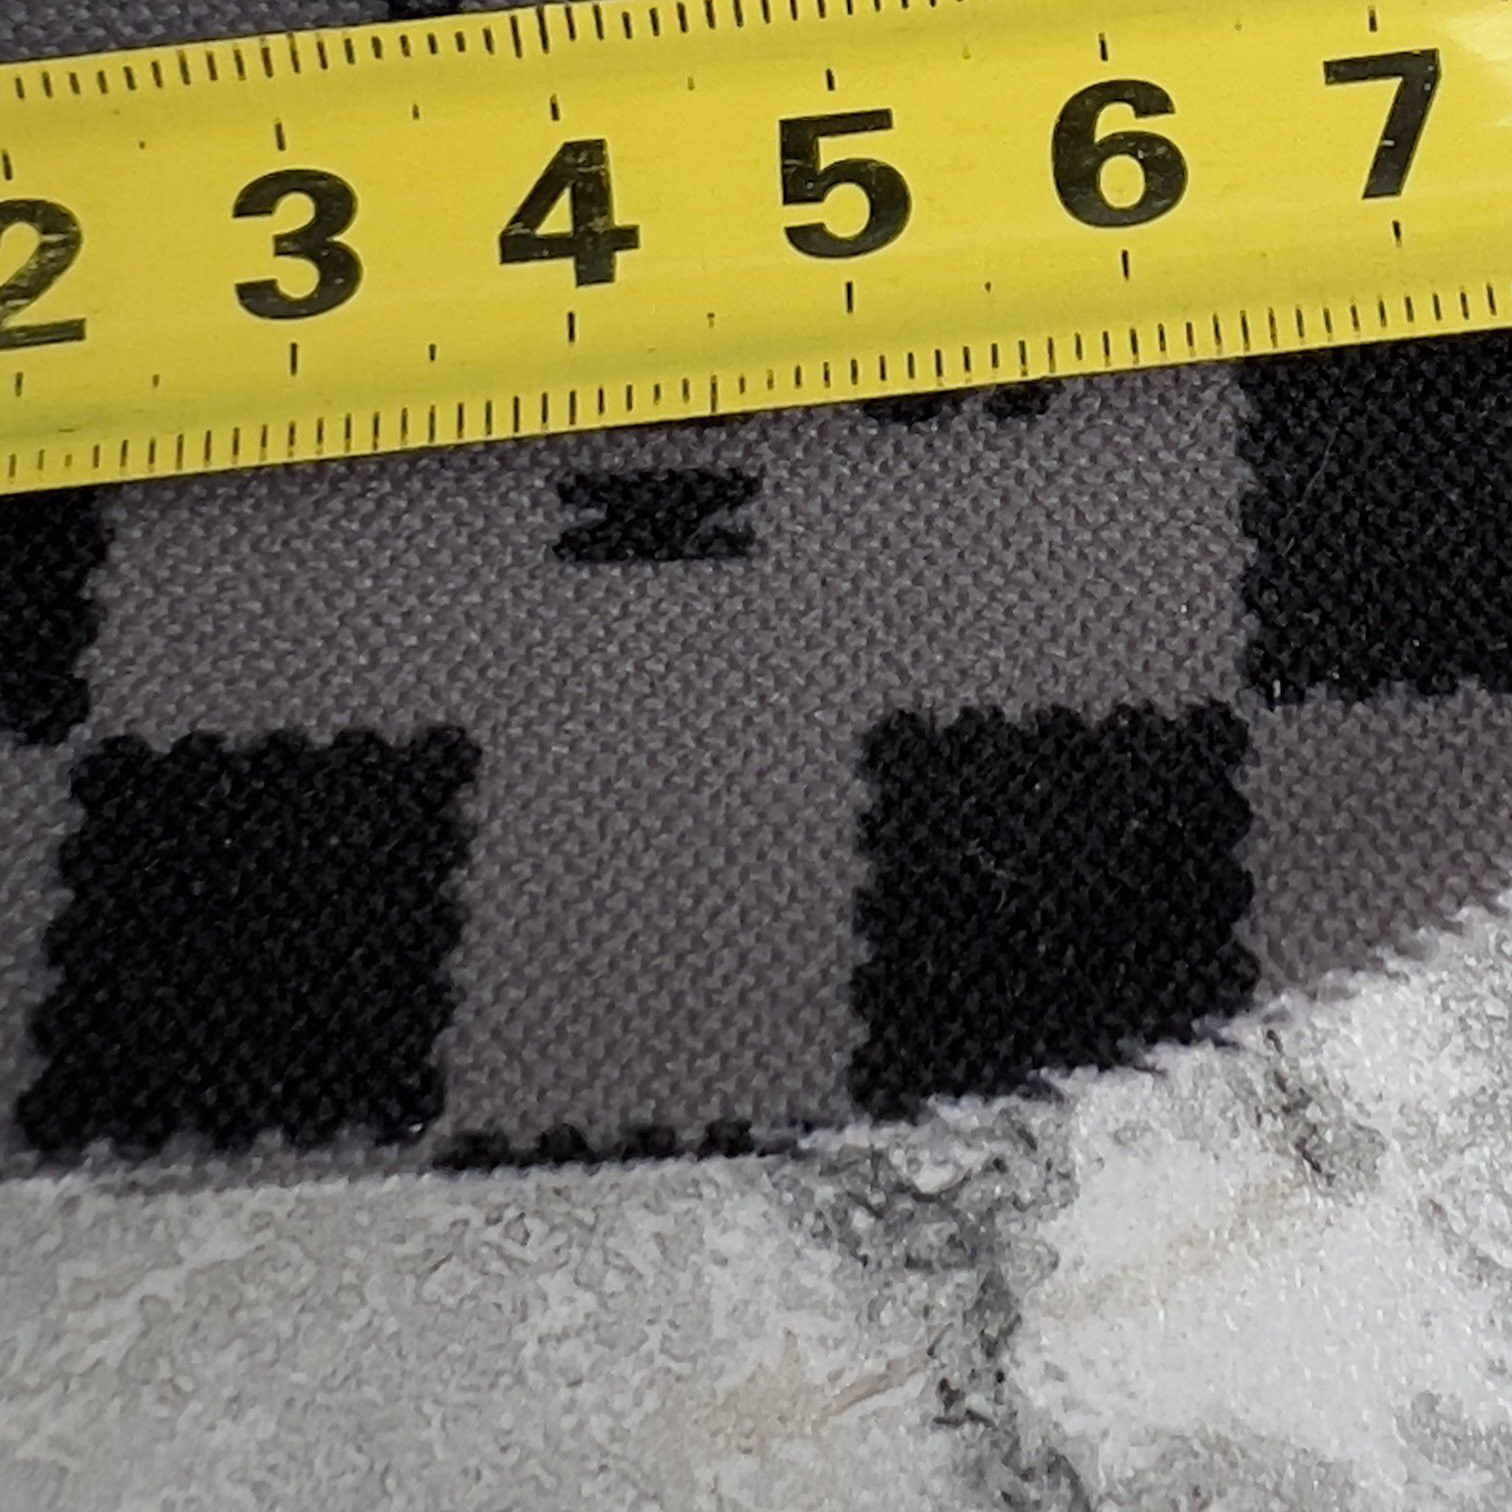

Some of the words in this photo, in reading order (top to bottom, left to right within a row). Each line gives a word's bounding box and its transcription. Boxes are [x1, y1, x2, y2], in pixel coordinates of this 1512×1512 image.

[232, 169, 362, 320] 3
[499, 139, 639, 288] 4
[779, 109, 911, 259] 5
[1051, 80, 1188, 228] 6
[1323, 49, 1441, 199] 7
